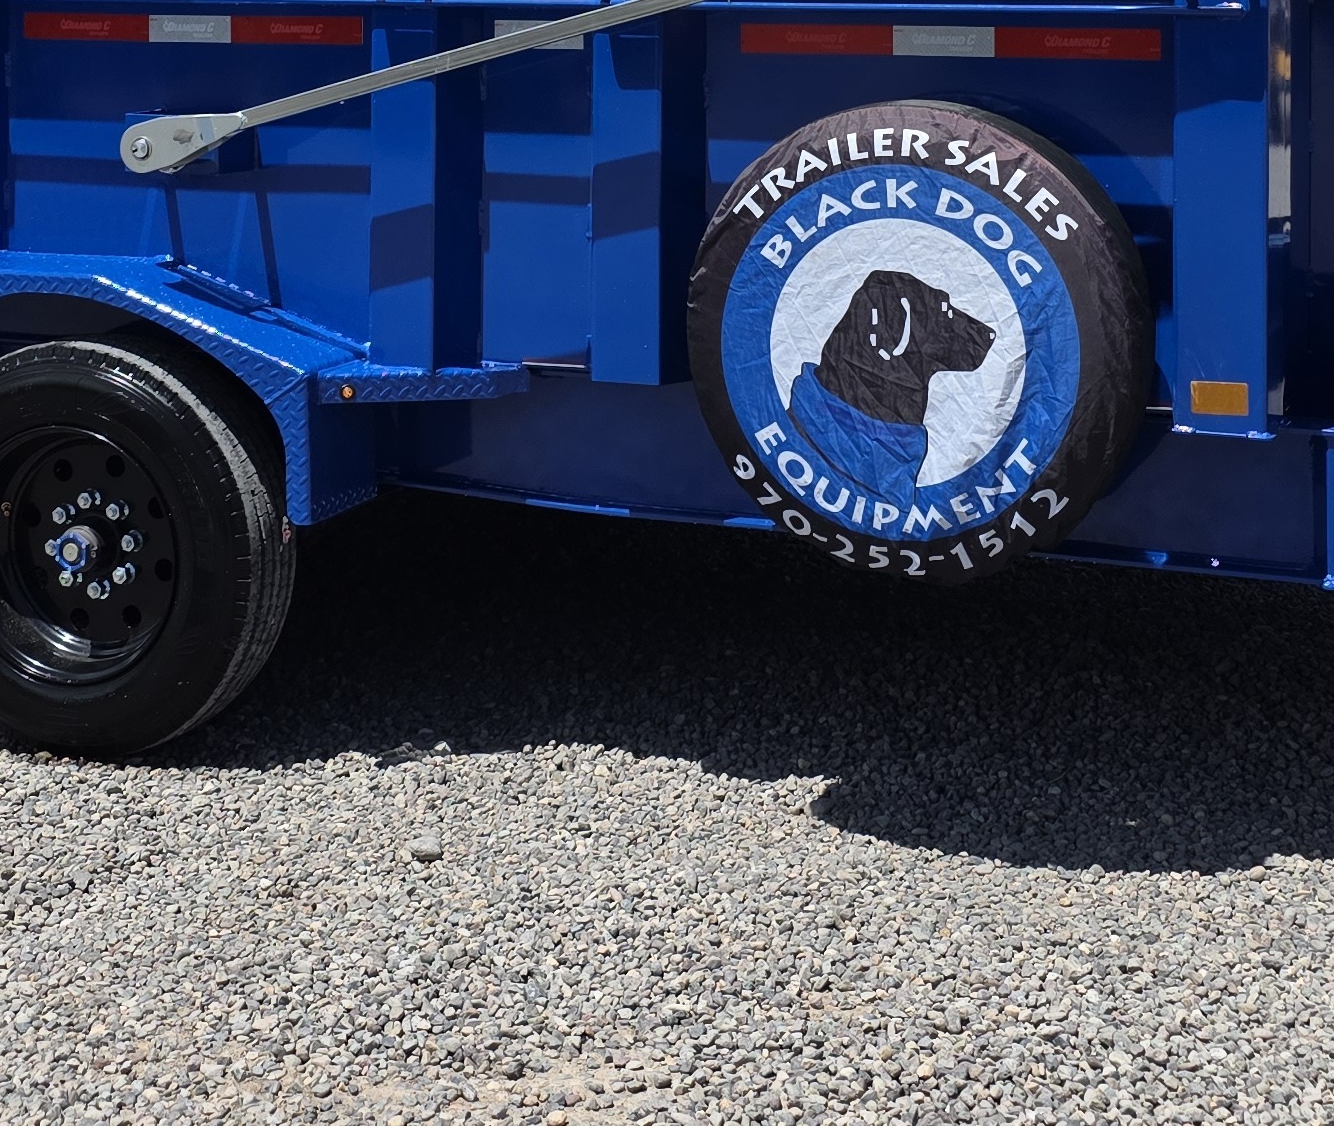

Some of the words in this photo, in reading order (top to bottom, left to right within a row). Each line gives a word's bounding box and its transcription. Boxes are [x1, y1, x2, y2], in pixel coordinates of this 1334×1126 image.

[732, 127, 929, 221] TRAILER
[944, 139, 1079, 242] SALES
[760, 178, 917, 269] BLACK
[934, 186, 1043, 289] DOG
[732, 453, 1069, 576] 970-252-1512
[754, 421, 1037, 534] EQUIPMENT
